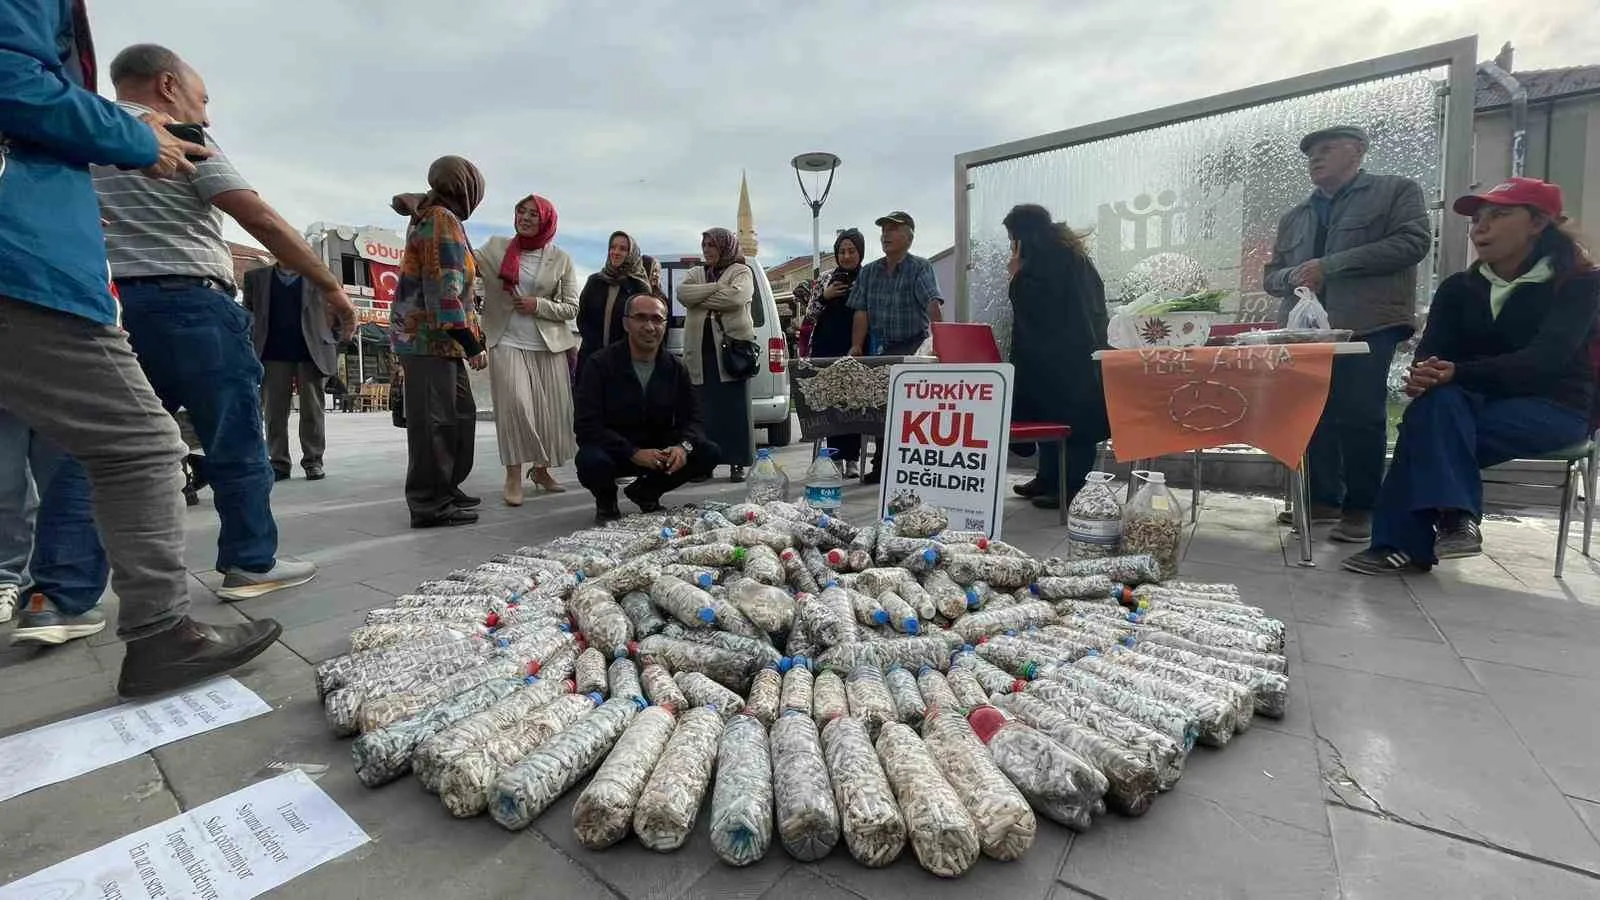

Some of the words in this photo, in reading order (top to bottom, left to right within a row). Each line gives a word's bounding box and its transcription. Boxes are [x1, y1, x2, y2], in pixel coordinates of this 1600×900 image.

[1138, 347, 1195, 375] YERE
[1209, 346, 1295, 374] ATMA
[903, 379, 994, 401] TÜRKİYE
[901, 402, 988, 449] KÜL
[898, 447, 987, 471] TABLASI
[895, 468, 985, 493] DEĞİLDİR!
